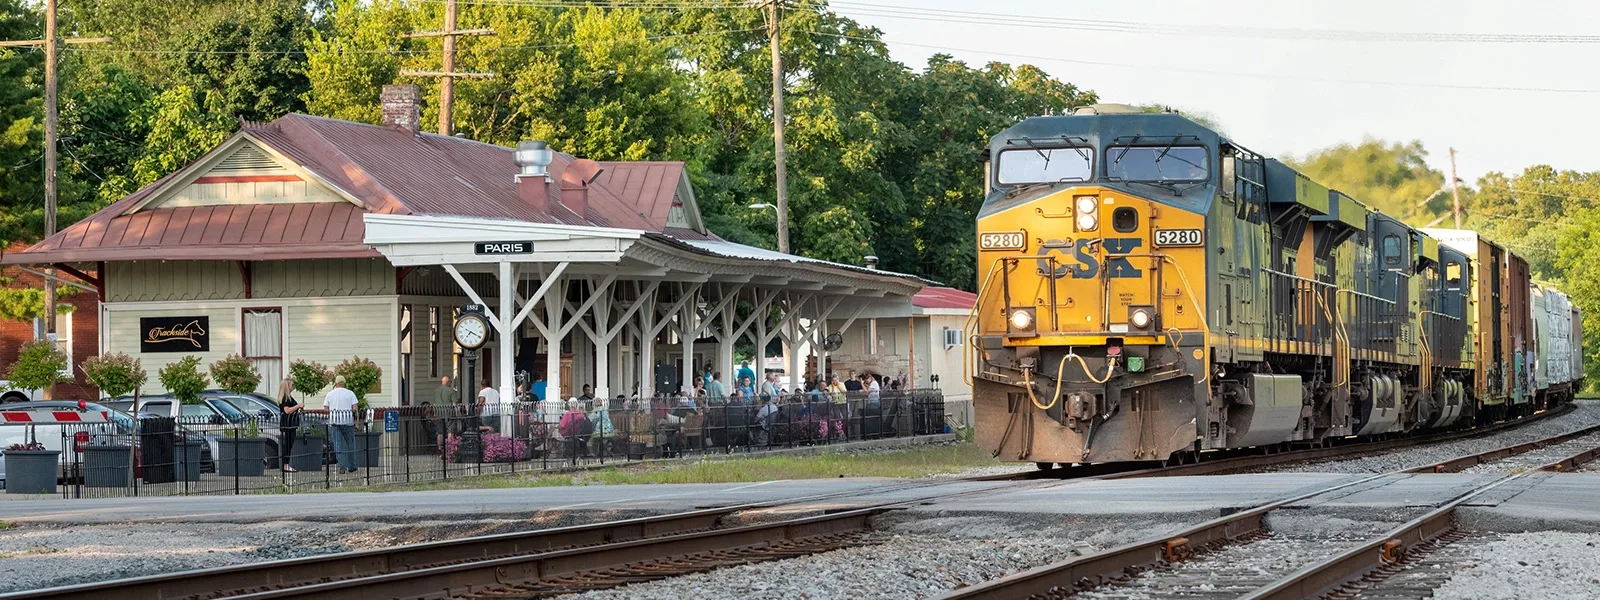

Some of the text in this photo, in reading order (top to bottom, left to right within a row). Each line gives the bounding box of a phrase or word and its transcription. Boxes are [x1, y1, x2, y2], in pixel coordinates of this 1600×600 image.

[984, 234, 1020, 247] 5280
[1158, 230, 1198, 244] 5280
[484, 243, 523, 253] PARIS
[1036, 238, 1142, 279] CSX
[148, 324, 190, 340] Trackside
